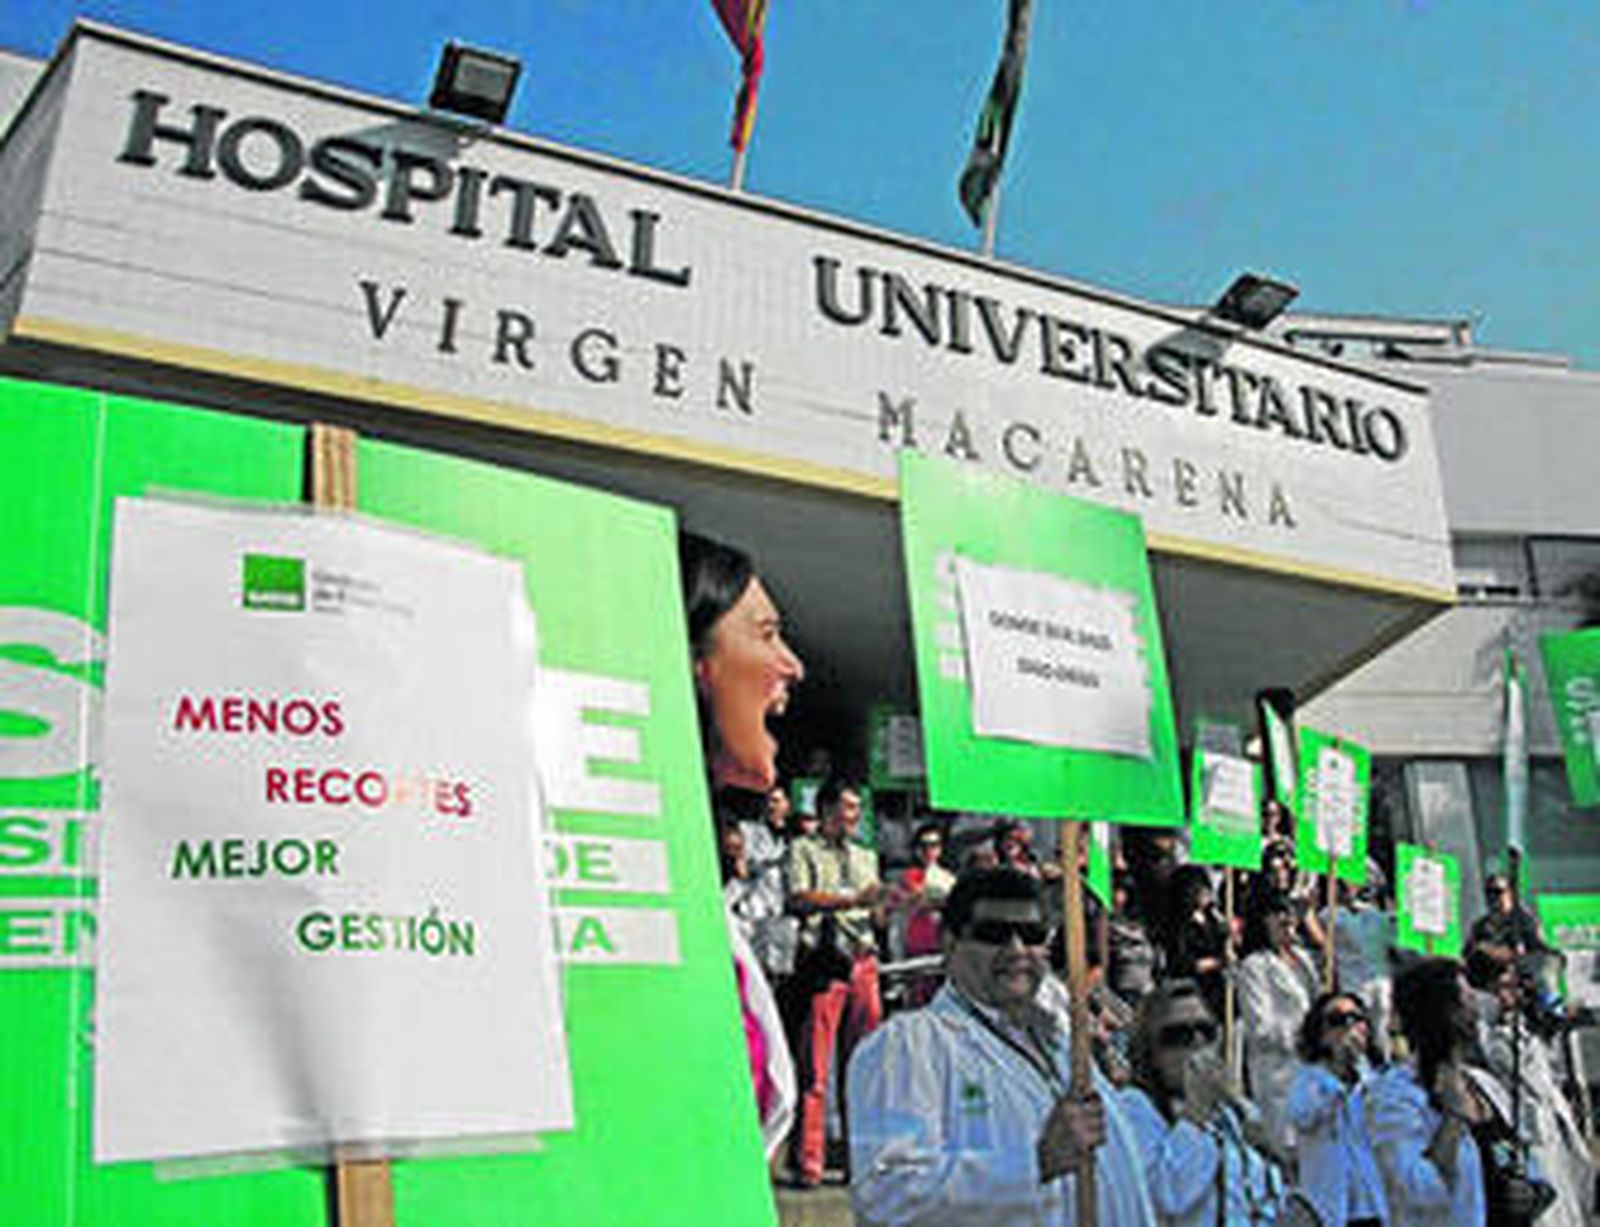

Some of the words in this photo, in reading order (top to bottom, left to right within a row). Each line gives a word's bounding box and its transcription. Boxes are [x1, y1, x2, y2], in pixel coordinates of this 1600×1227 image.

[117, 89, 692, 287] HOSPITAL
[813, 255, 1409, 462] UNIVERSITARIO
[359, 280, 757, 415] VIRGEN
[876, 390, 1298, 528] MACARENA
[174, 696, 345, 736] MENOS
[265, 767, 472, 817] RECOES
[171, 838, 340, 880] MEJOR
[297, 905, 475, 956] GESTIÓN
